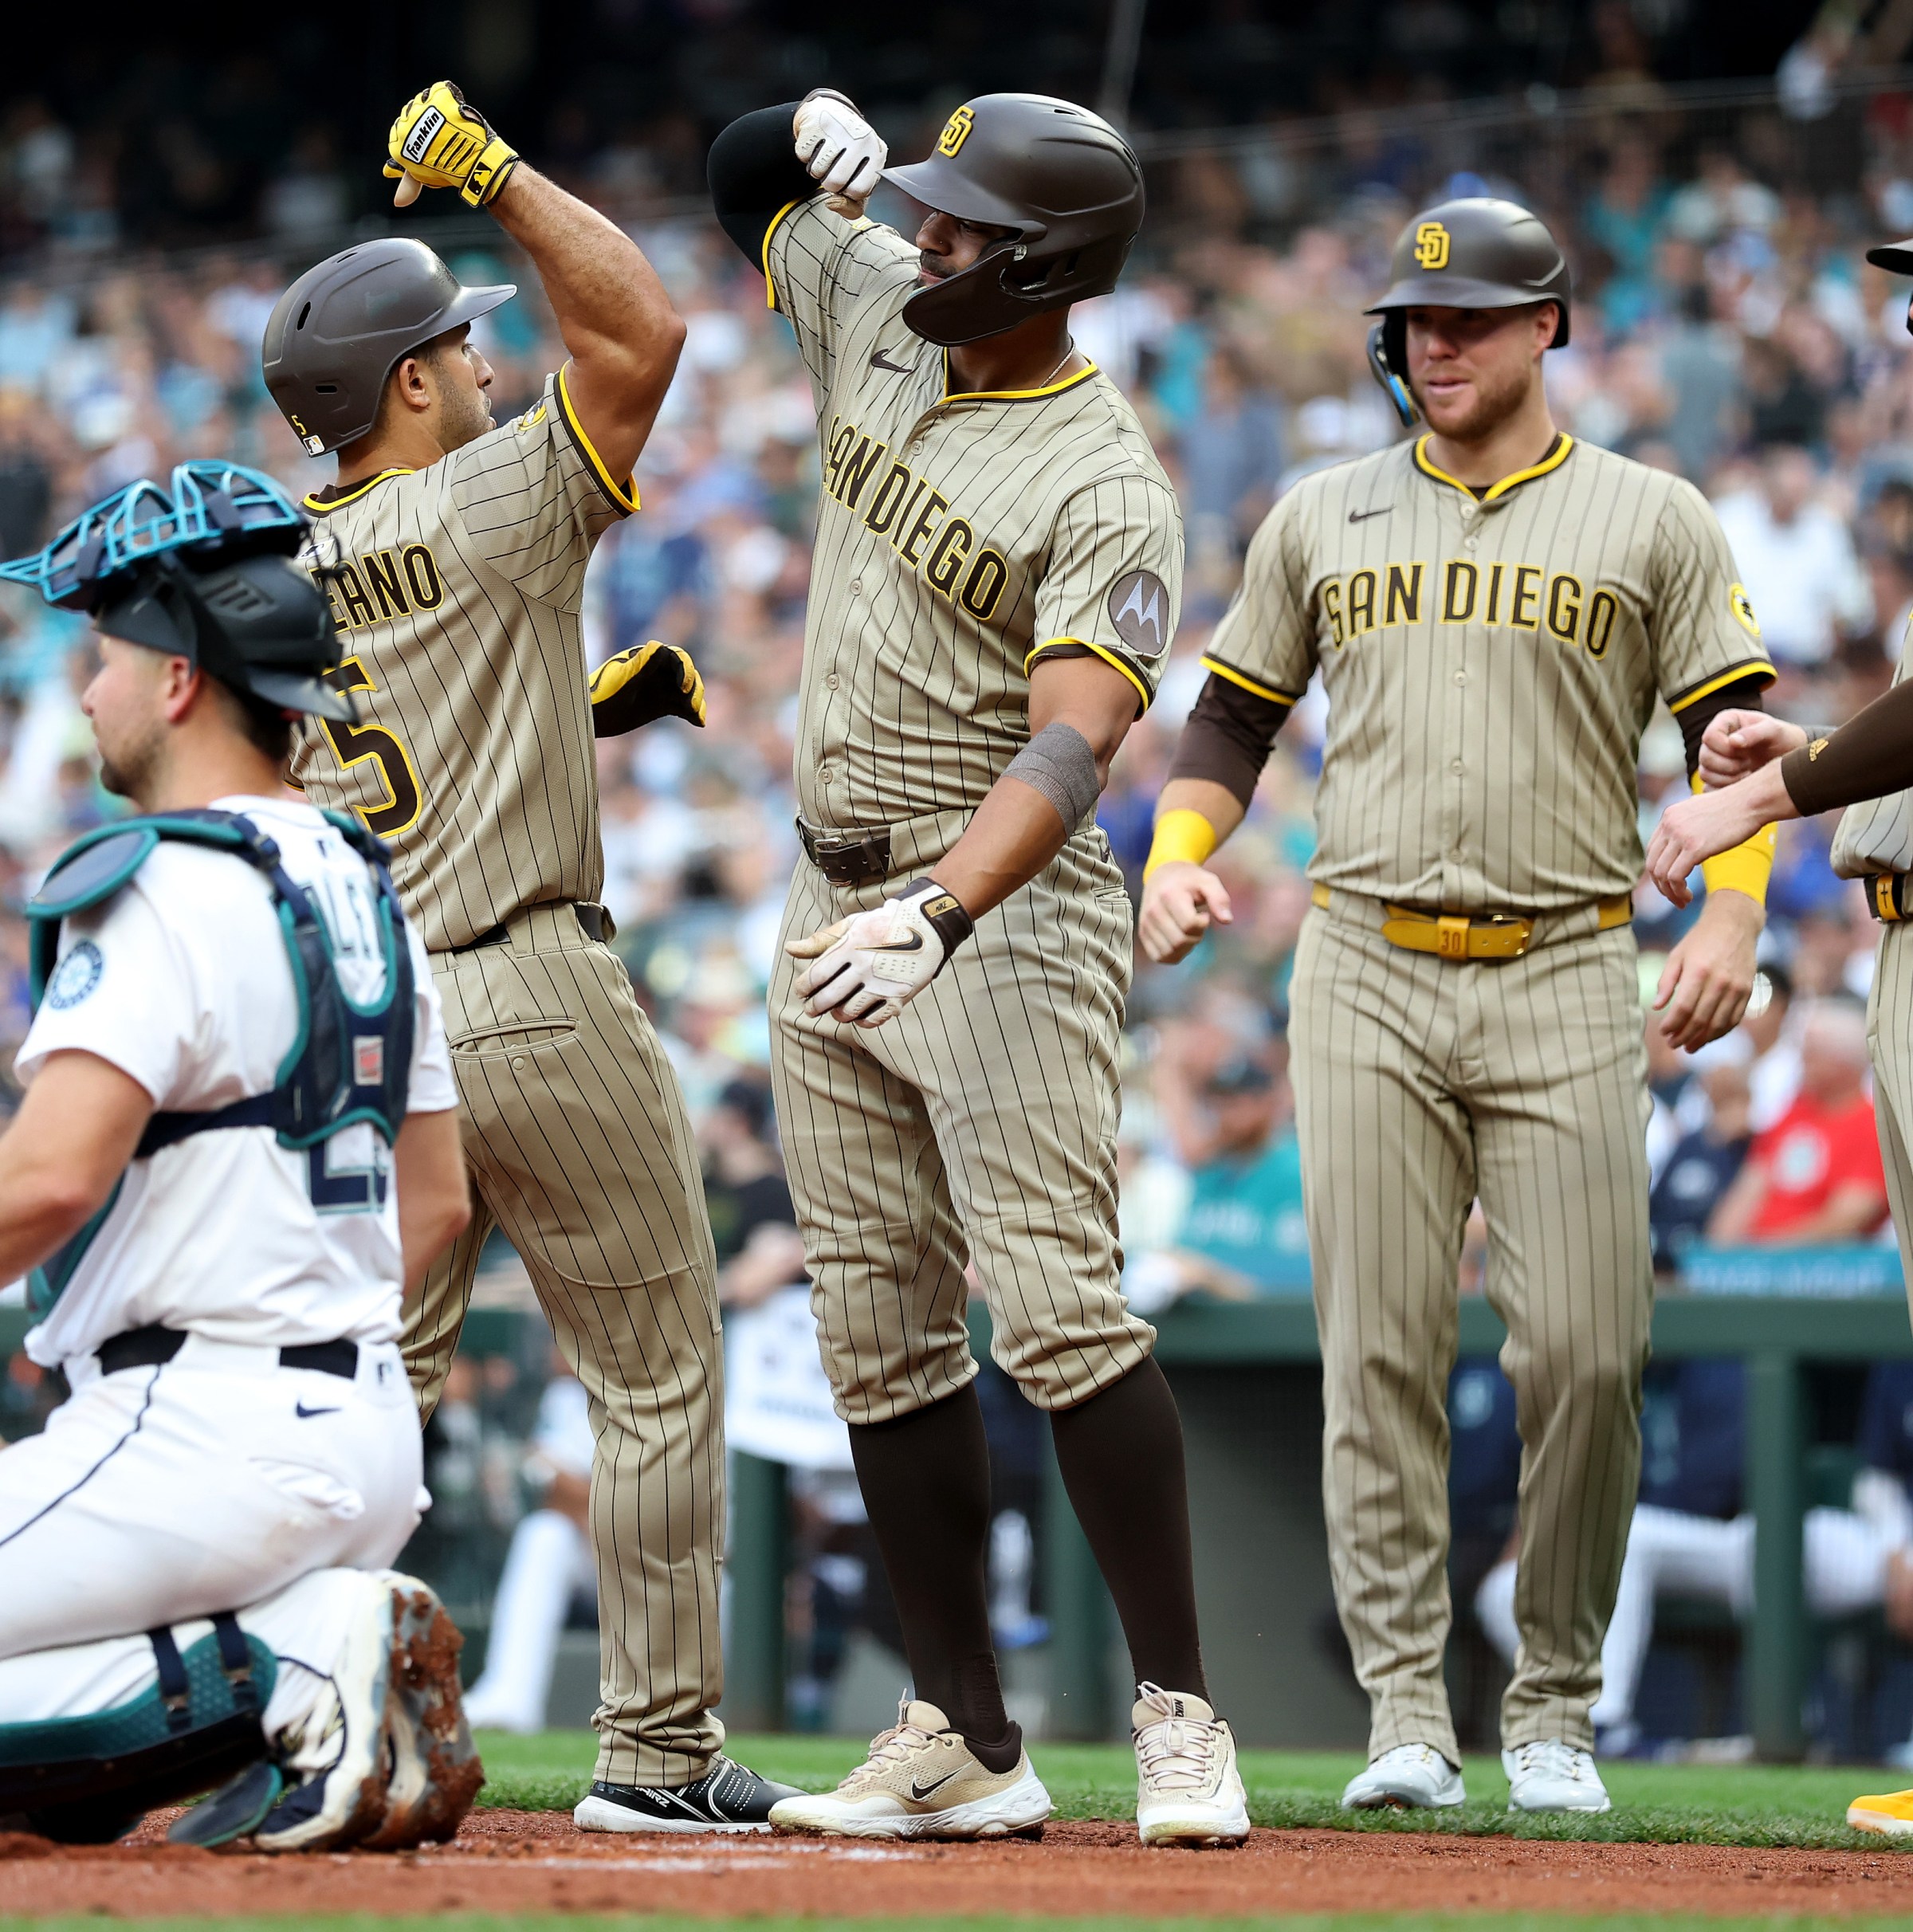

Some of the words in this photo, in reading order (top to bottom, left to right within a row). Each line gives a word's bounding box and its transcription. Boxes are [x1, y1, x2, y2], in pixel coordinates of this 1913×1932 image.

[937, 105, 976, 159] SD
[1414, 222, 1451, 269] SD
[291, 414, 307, 436] 5
[862, 454, 1009, 622] DIEGO
[1323, 562, 1426, 652] SAN
[1439, 558, 1620, 661] DIEGO
[318, 654, 422, 840] 5
[1440, 929, 1461, 953] 30
